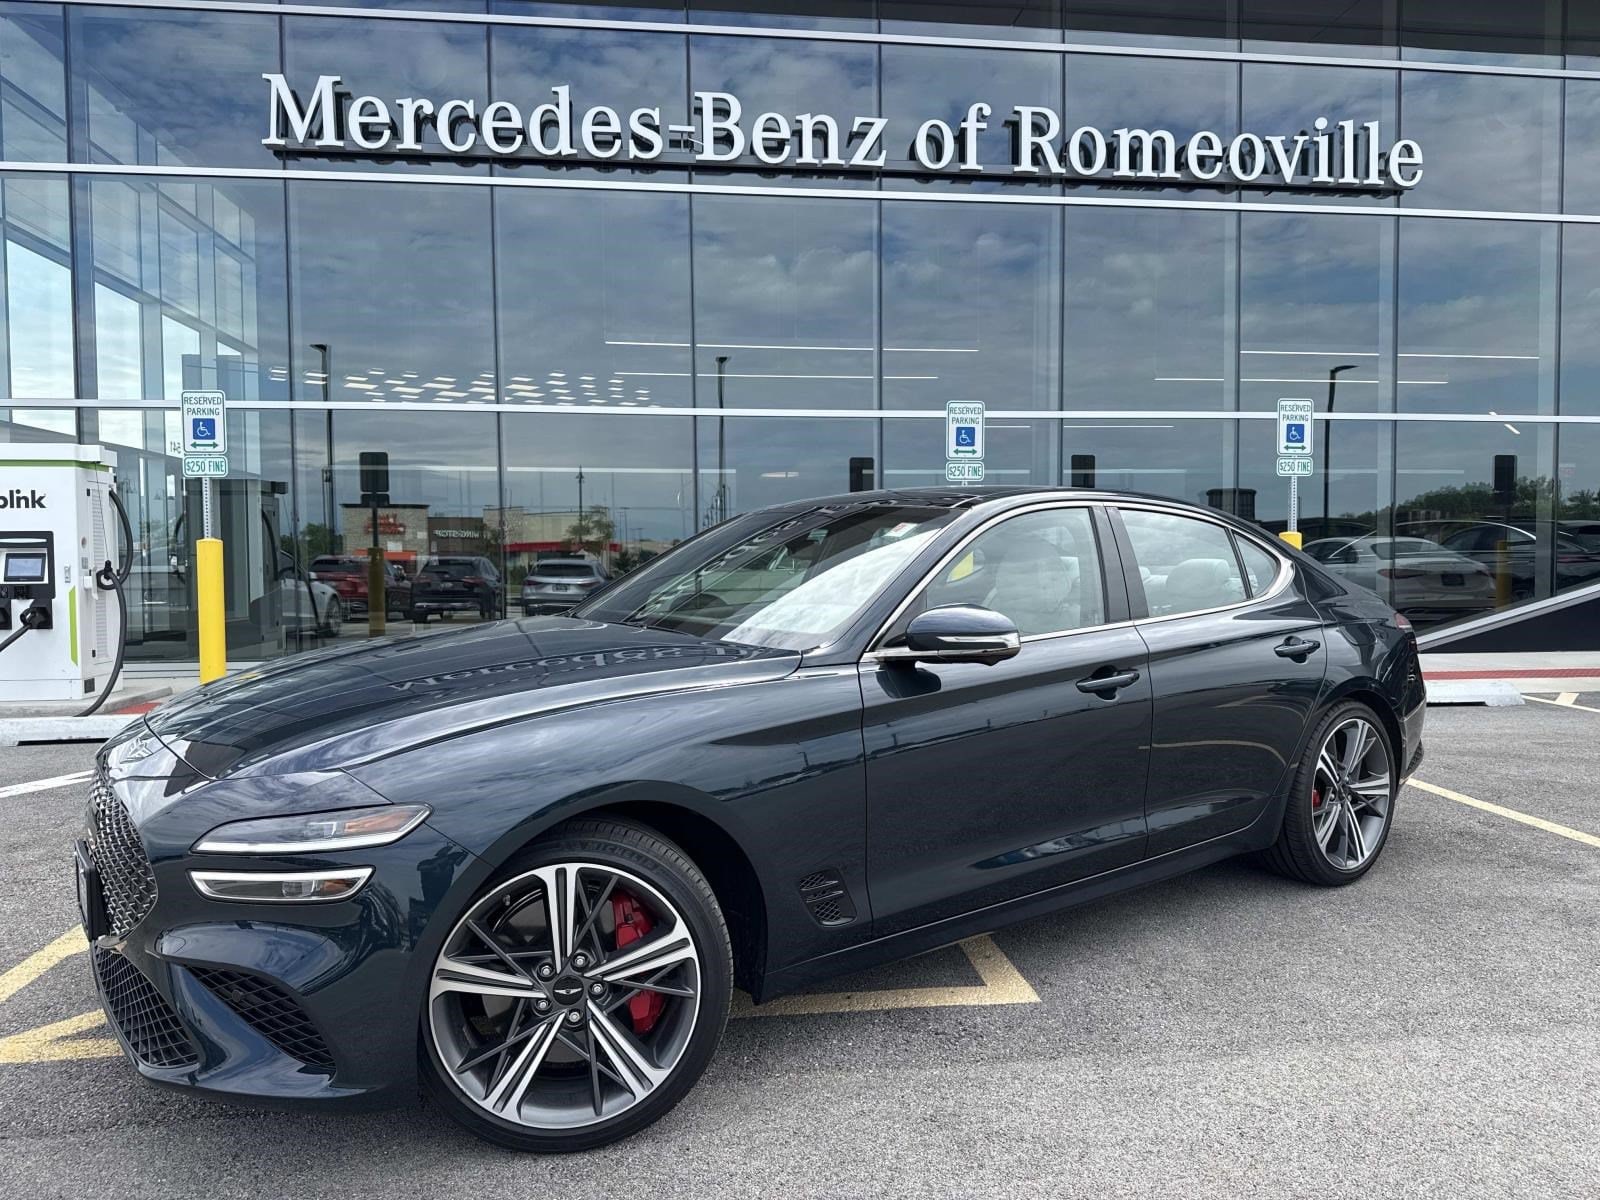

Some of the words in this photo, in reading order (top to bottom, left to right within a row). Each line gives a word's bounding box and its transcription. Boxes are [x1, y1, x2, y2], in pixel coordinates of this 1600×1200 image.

[261, 73, 889, 168] Mercedes-Benz
[914, 102, 992, 172] of
[1012, 105, 1424, 187] Romeoville
[183, 396, 222, 405] RESERVED
[186, 407, 220, 416] PARKING
[949, 406, 982, 415] RESERVED
[1280, 404, 1311, 412] RESERVED
[951, 416, 980, 425] PARKING
[1282, 414, 1309, 422] PARKING
[186, 460, 206, 473] $250
[208, 460, 225, 473] FINE
[949, 465, 966, 477] $250
[967, 465, 982, 477] FINE
[1279, 461, 1296, 472] $250
[1297, 461, 1311, 472] FINE
